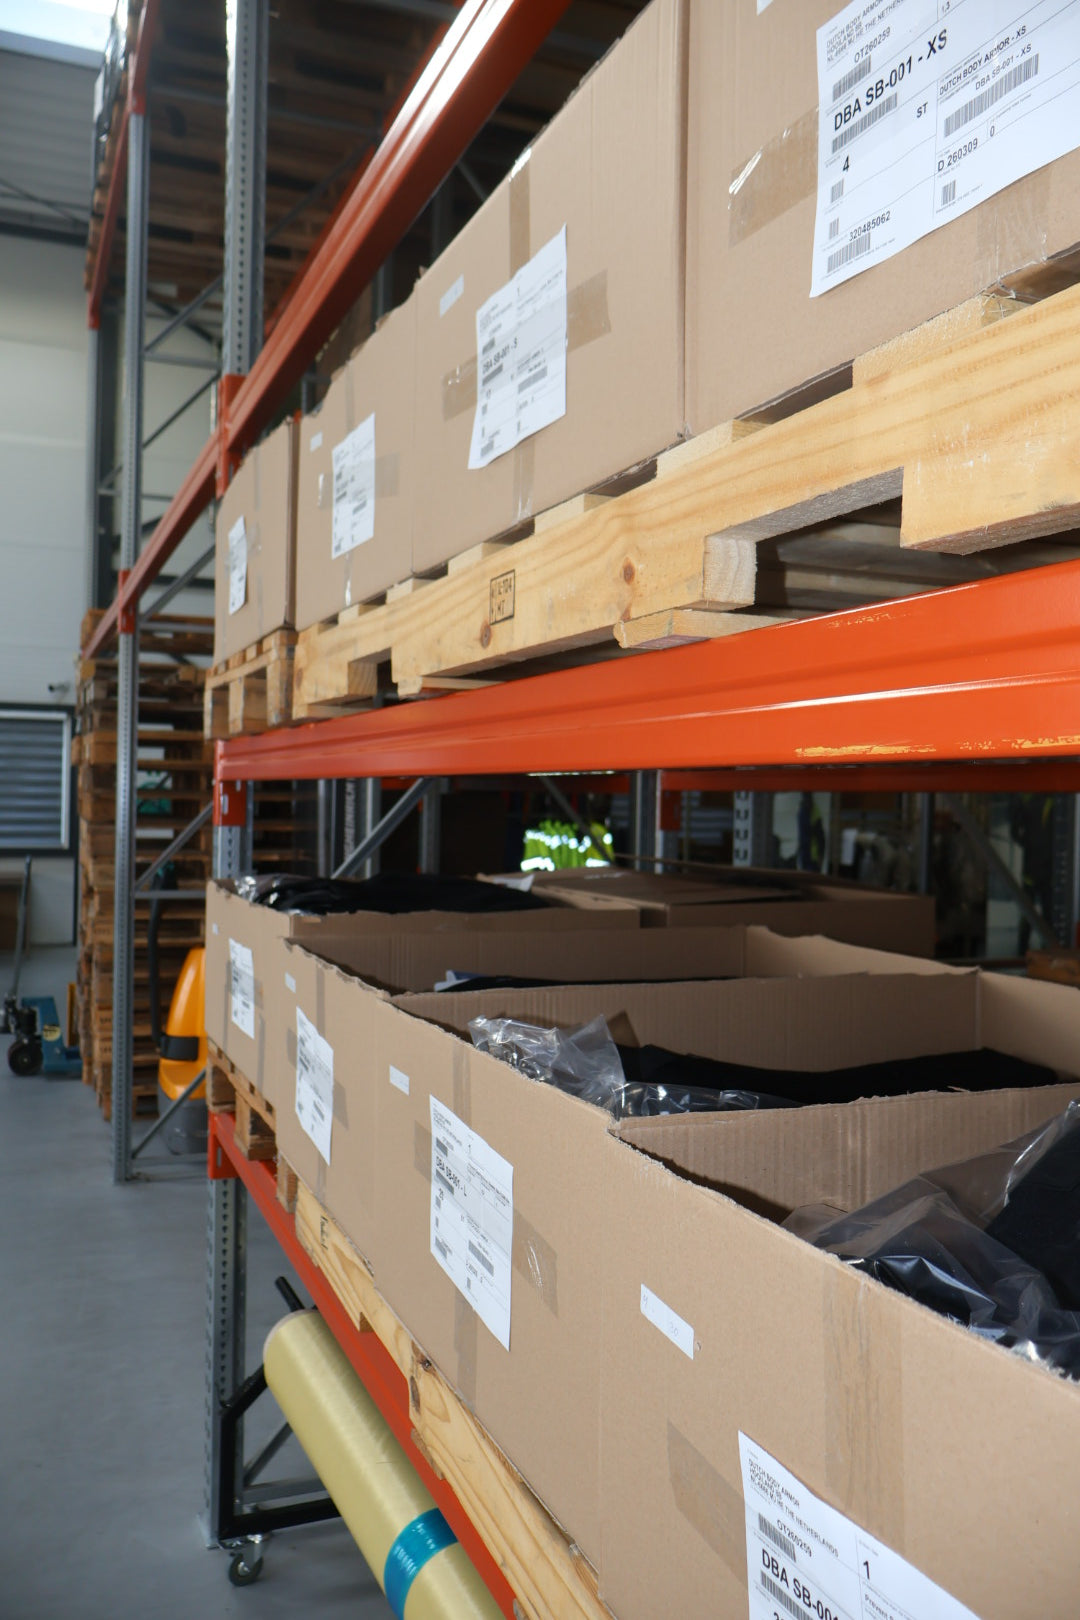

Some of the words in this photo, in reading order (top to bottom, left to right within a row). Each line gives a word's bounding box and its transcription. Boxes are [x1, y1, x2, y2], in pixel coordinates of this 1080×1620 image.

[939, 74, 962, 95] DUTCH
[963, 57, 983, 78] BODY
[984, 36, 1010, 63] ARMOR
[1015, 25, 1027, 39] XS
[975, 75, 991, 90] DBA
[1020, 44, 1032, 57] XS
[834, 97, 862, 131] DBA
[865, 55, 912, 106] SB-001
[926, 28, 947, 60] XS
[916, 101, 928, 118] ST
[843, 155, 850, 173] 4
[937, 160, 945, 172] D
[947, 138, 978, 168] 260309
[849, 210, 891, 241] 320485062
[762, 1548, 789, 1589] DBA
[793, 1577, 838, 1620] SB-00
[863, 1560, 870, 1580] 1
